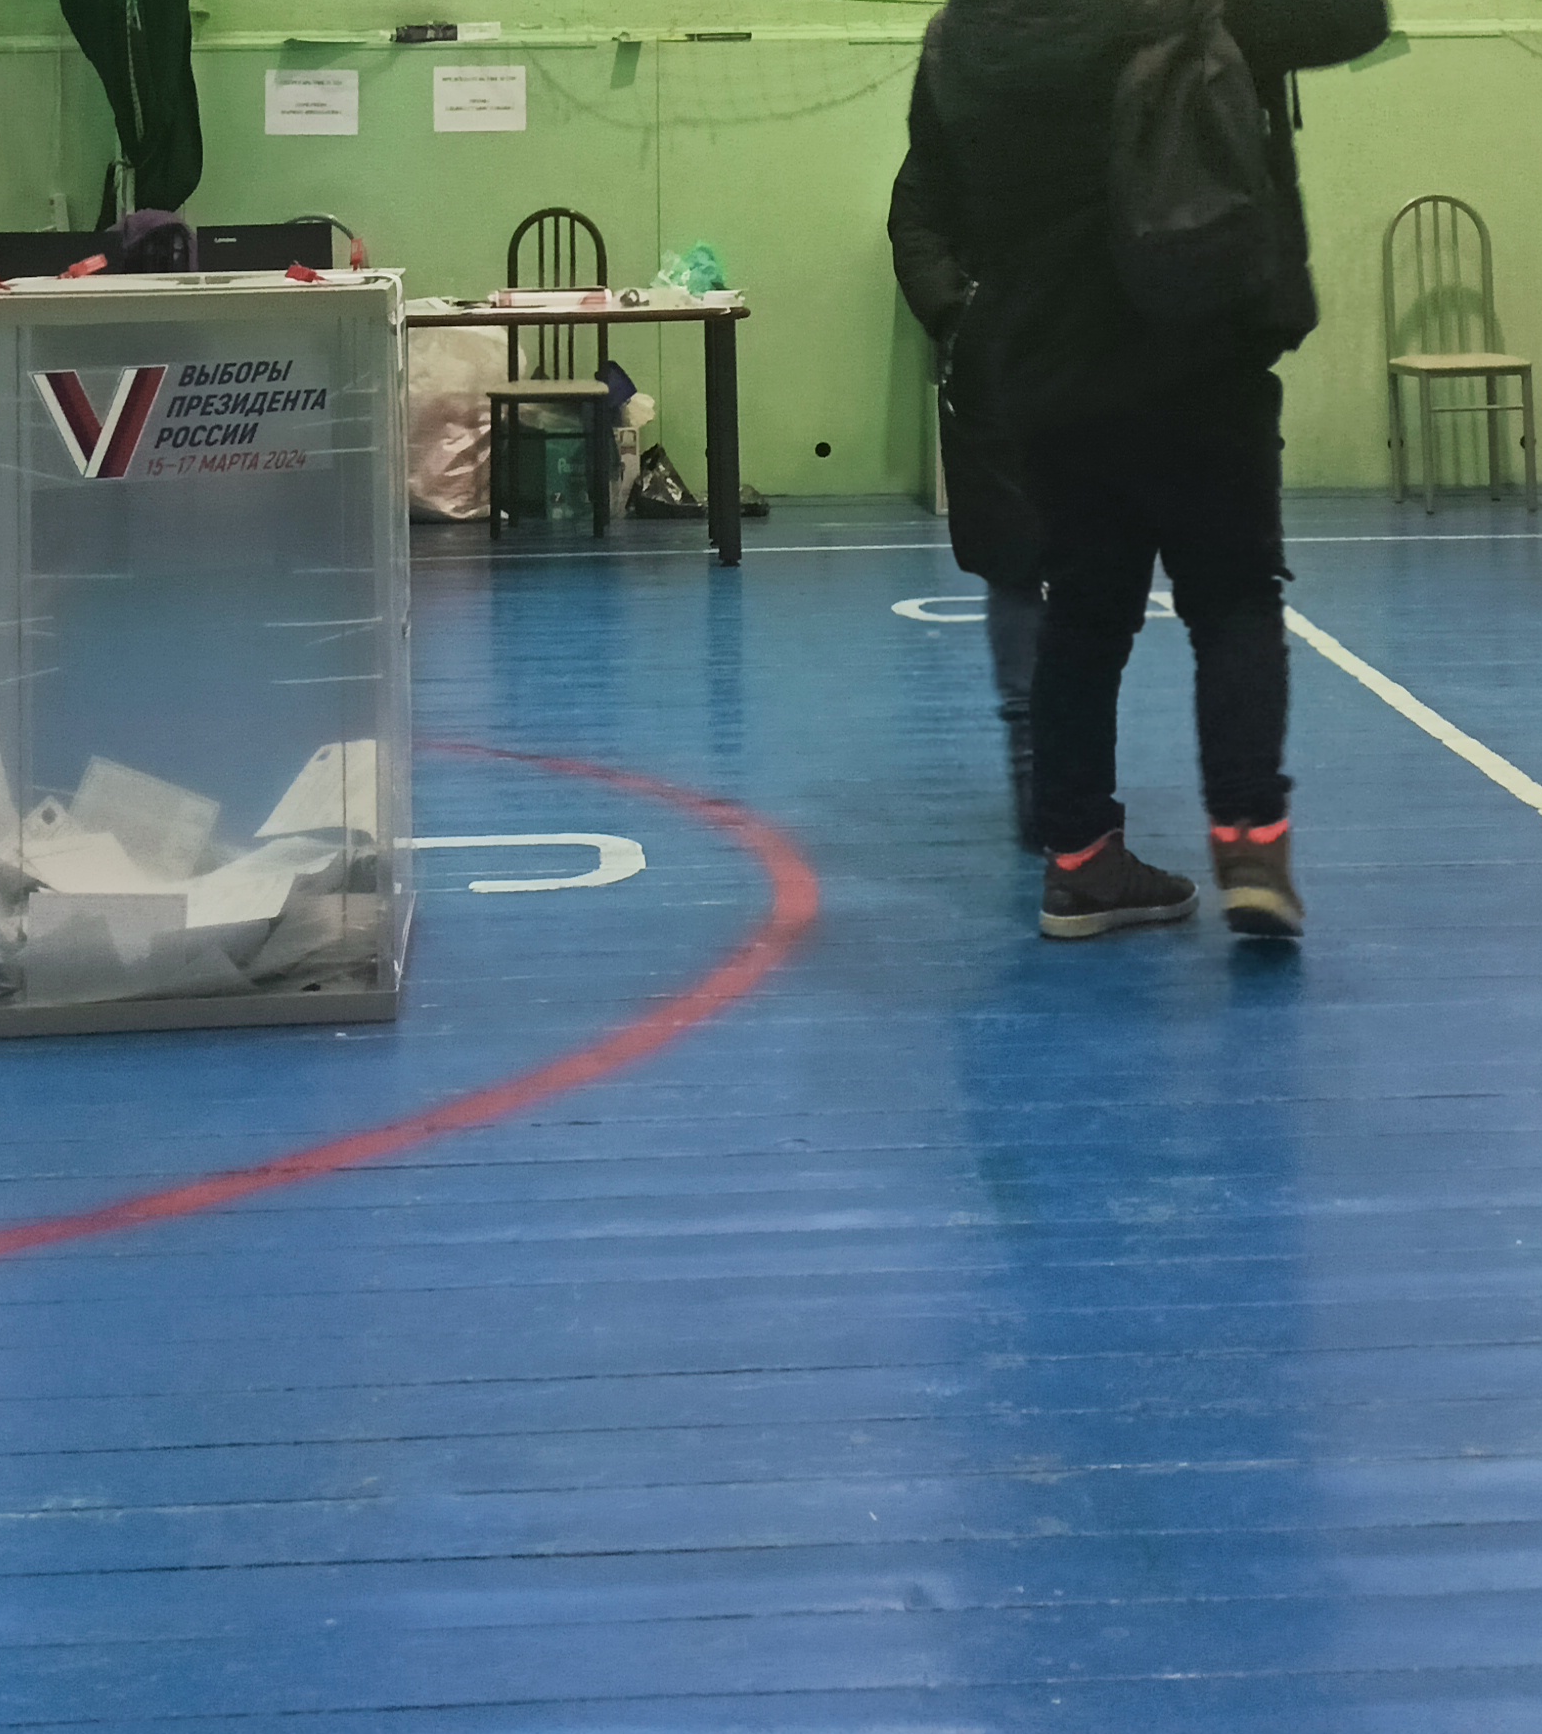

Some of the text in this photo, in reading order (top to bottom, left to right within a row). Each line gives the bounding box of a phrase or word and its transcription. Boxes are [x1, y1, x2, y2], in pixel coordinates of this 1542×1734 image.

[178, 360, 293, 387] ВЫБОРЫ
[166, 388, 327, 418] ПРЕЗИДЕНТА
[154, 422, 259, 450] РОССИИ
[198, 452, 260, 474] МАРТА
[262, 449, 307, 471] 2024
